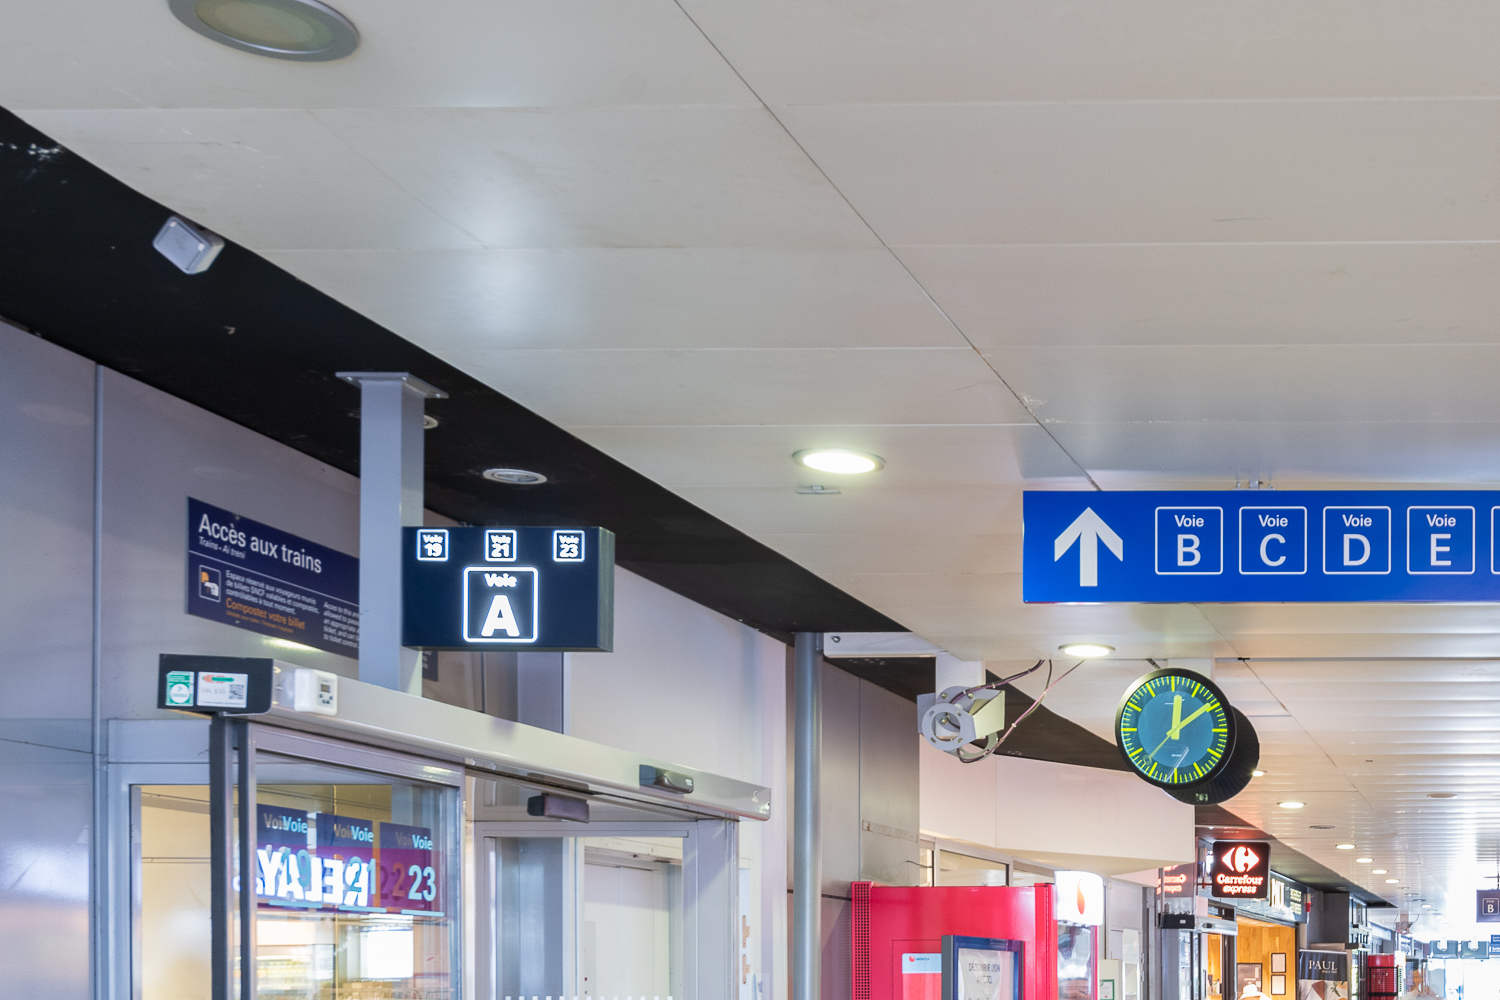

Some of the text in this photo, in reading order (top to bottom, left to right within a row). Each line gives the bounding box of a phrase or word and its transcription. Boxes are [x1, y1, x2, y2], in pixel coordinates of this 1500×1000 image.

[1175, 515, 1204, 527] Voie
[1259, 515, 1288, 527] Voie
[1343, 515, 1372, 526] Voie
[1427, 514, 1456, 526] Voie
[198, 514, 322, 574] Accès aux trains
[424, 543, 443, 557] 19
[491, 543, 510, 557] 21
[559, 544, 579, 558] 23
[1178, 534, 1200, 566] B
[1260, 534, 1286, 566] C
[1344, 534, 1370, 565] D
[1431, 534, 1451, 565] E
[484, 572, 518, 587] Voie
[226, 597, 268, 619] Compostez
[268, 611, 287, 625] votre
[480, 594, 520, 637] A
[282, 816, 308, 833] Voie
[351, 826, 374, 843] Voie
[412, 834, 433, 850] Voie
[408, 865, 437, 902] 23
[1216, 873, 1264, 886] Carrefour
[1222, 885, 1257, 895] express
[1487, 904, 1494, 913] B
[1309, 960, 1338, 970] PAUL
